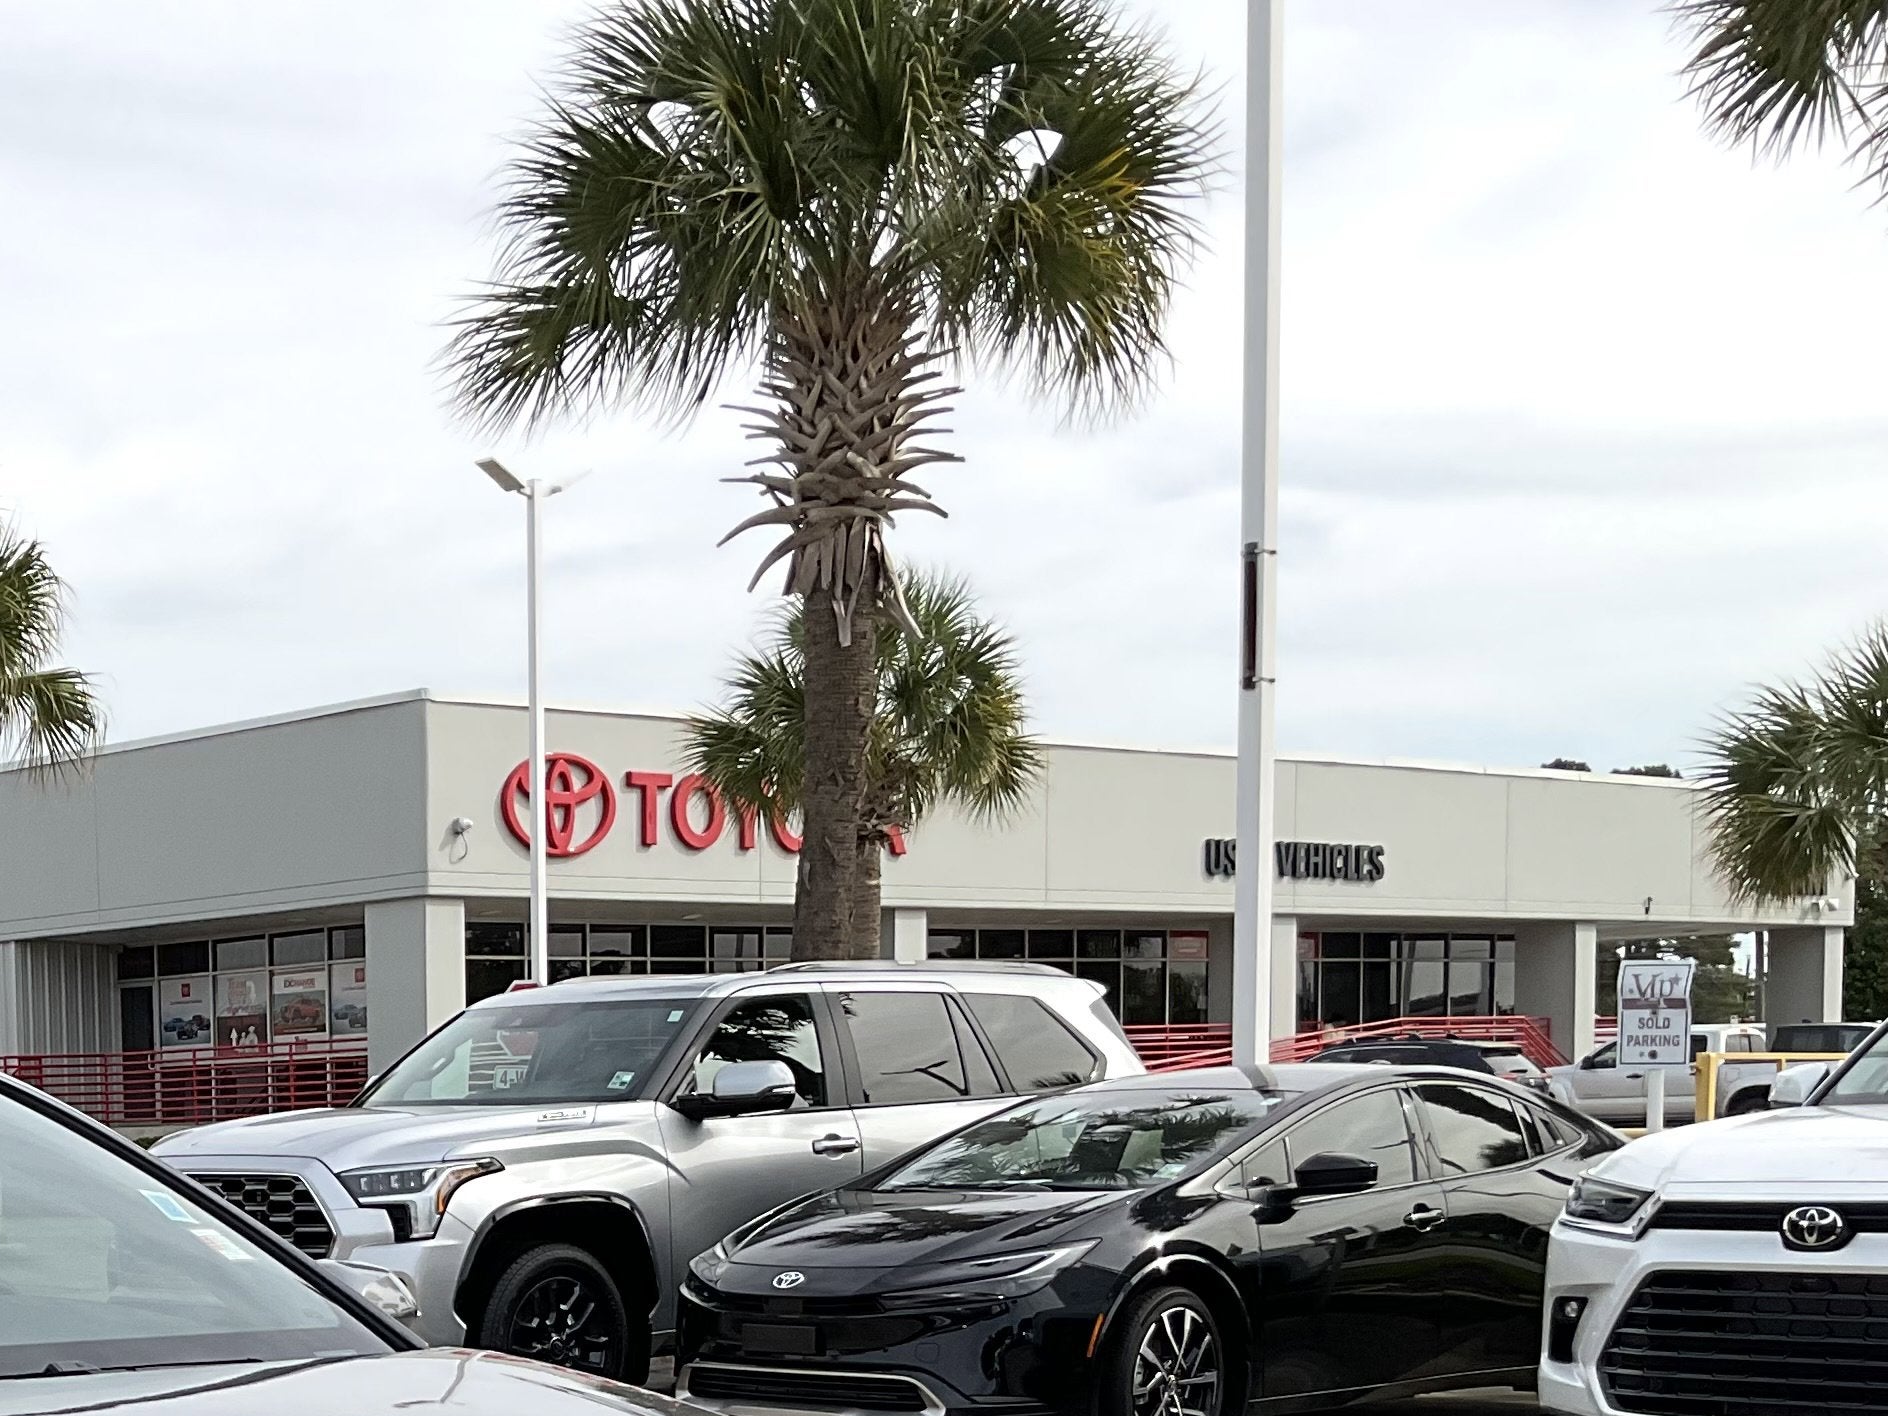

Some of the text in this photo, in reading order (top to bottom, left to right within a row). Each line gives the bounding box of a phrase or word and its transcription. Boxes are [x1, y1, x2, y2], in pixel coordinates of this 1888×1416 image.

[1205, 838, 1385, 882] US VEHICLES
[1637, 1016, 1671, 1030] SOLD
[1626, 1034, 1681, 1047] PARKING
